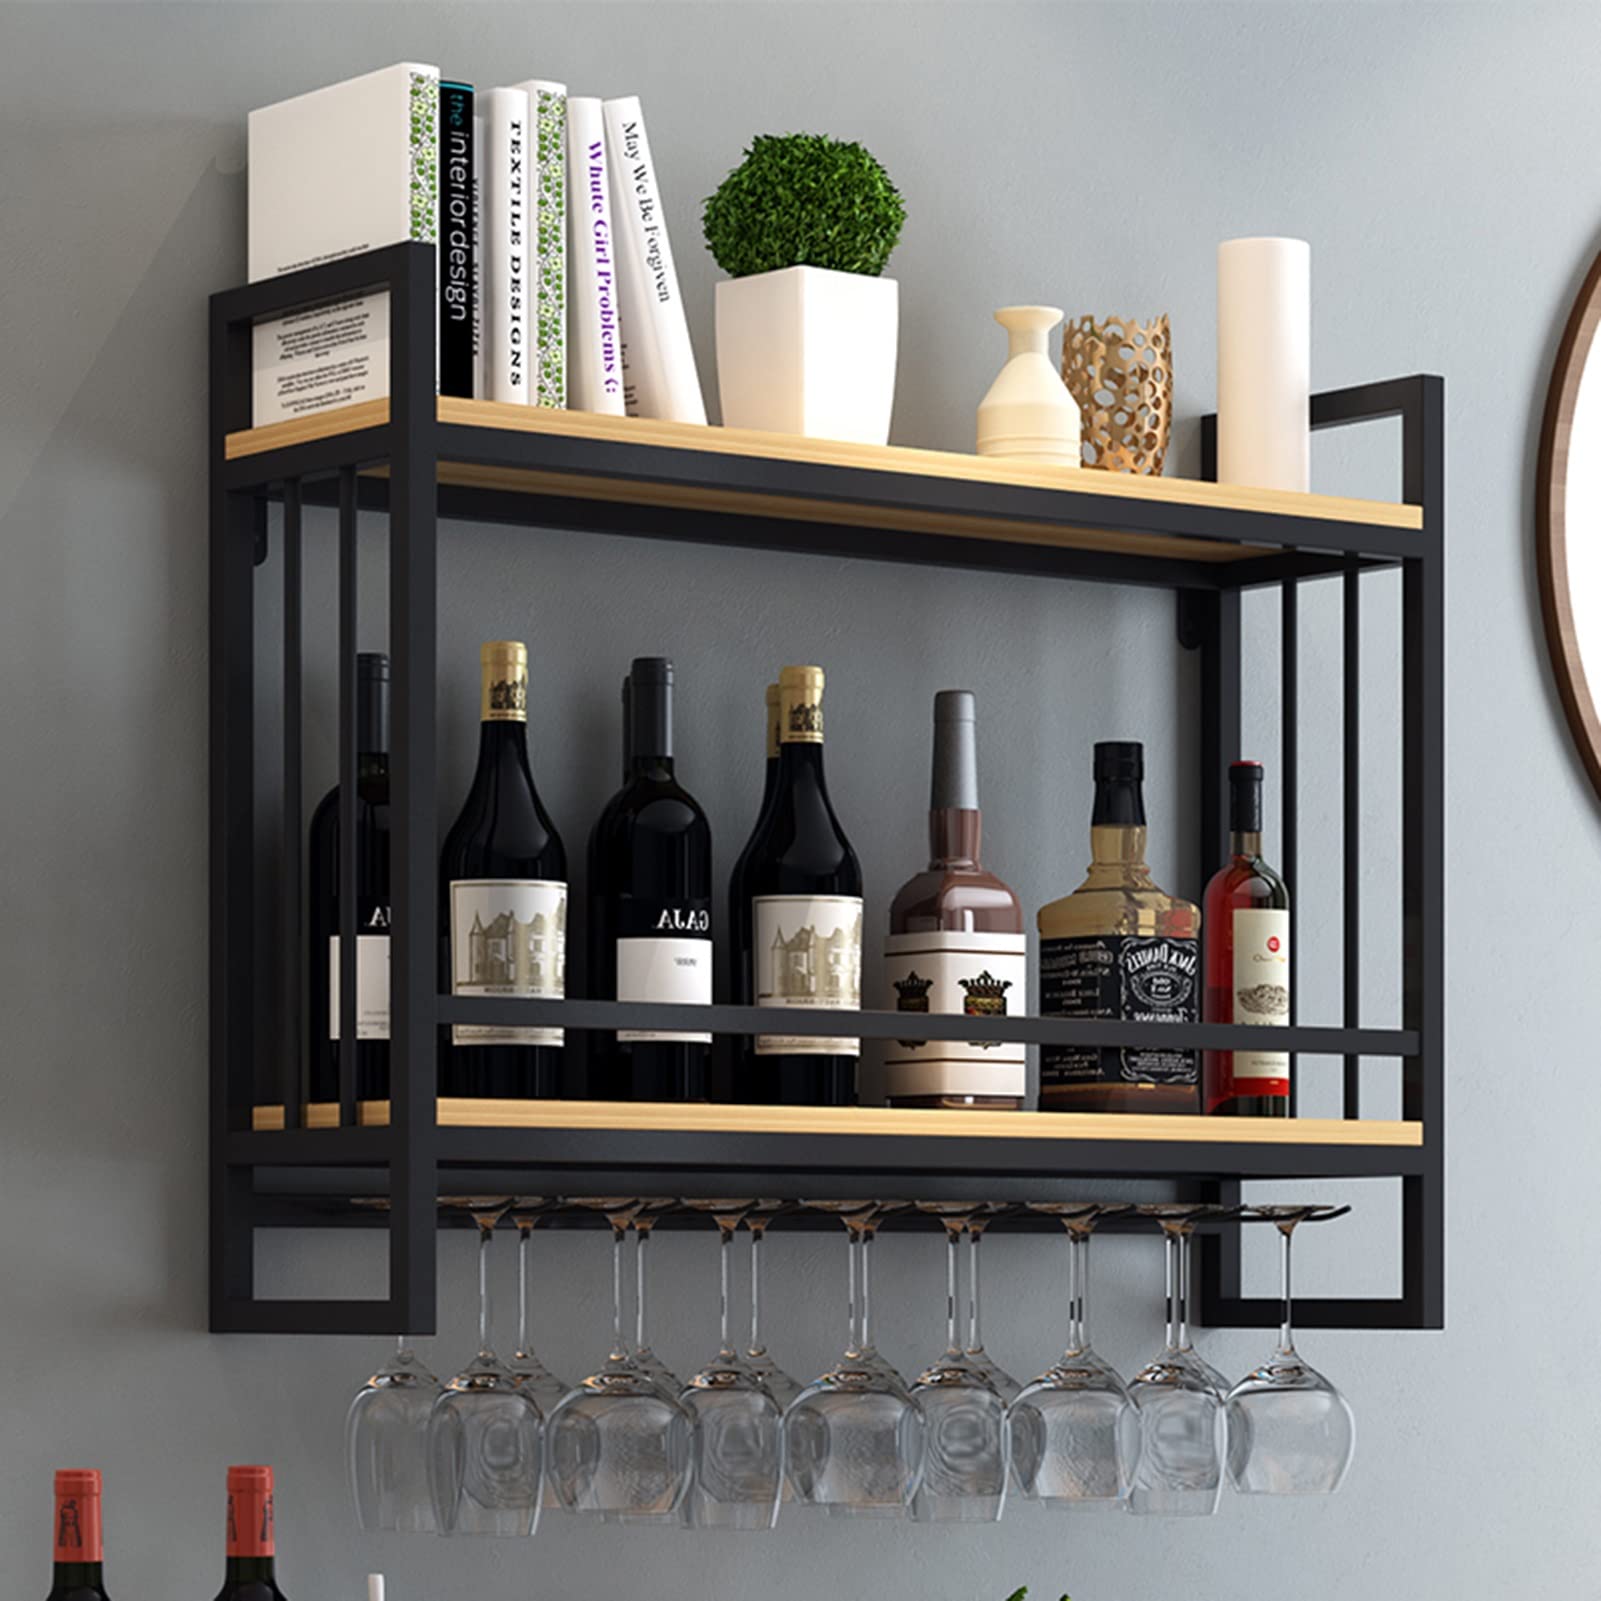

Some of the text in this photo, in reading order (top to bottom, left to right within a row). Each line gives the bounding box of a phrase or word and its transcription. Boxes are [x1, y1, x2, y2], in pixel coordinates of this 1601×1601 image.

[445, 94, 471, 321] the interior design
[510, 120, 521, 386] TEXTILE DESIGNS
[593, 219, 610, 264] Girl
[622, 121, 671, 303] May We Be Forgiven
[597, 271, 616, 372] Problems
